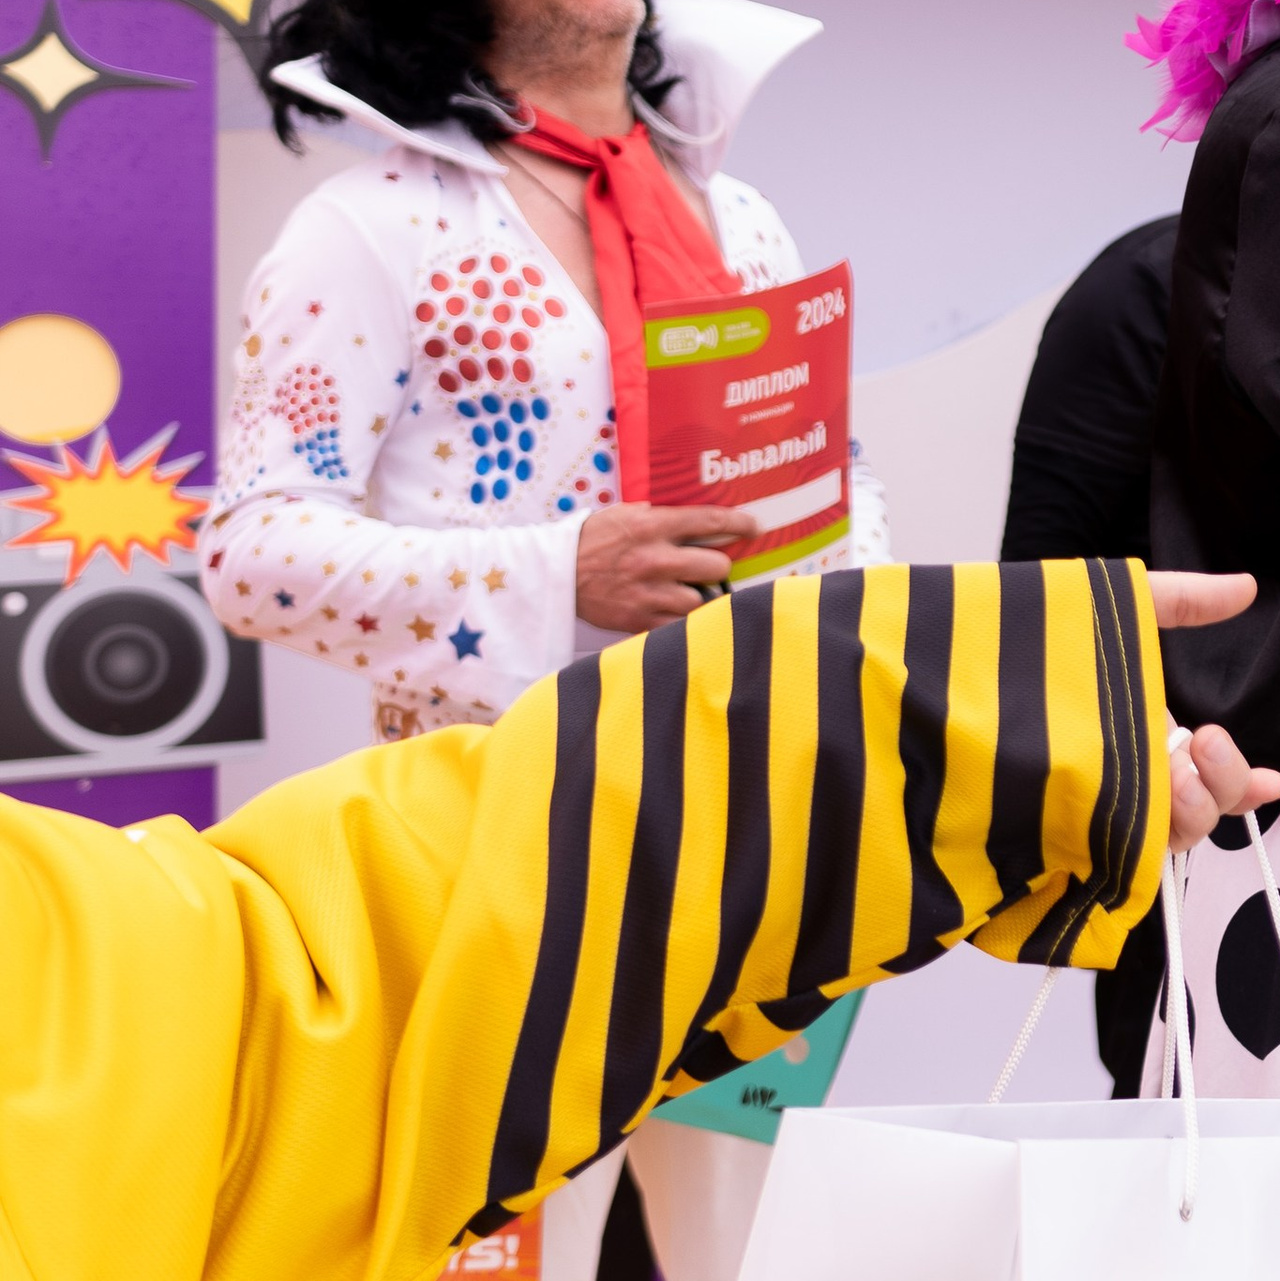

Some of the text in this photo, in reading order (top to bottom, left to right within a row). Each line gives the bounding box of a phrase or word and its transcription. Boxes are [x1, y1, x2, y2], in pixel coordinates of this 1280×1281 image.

[797, 287, 846, 334] 2024
[724, 361, 809, 408] ДИПЛОМ
[700, 421, 827, 485] Бывалый
